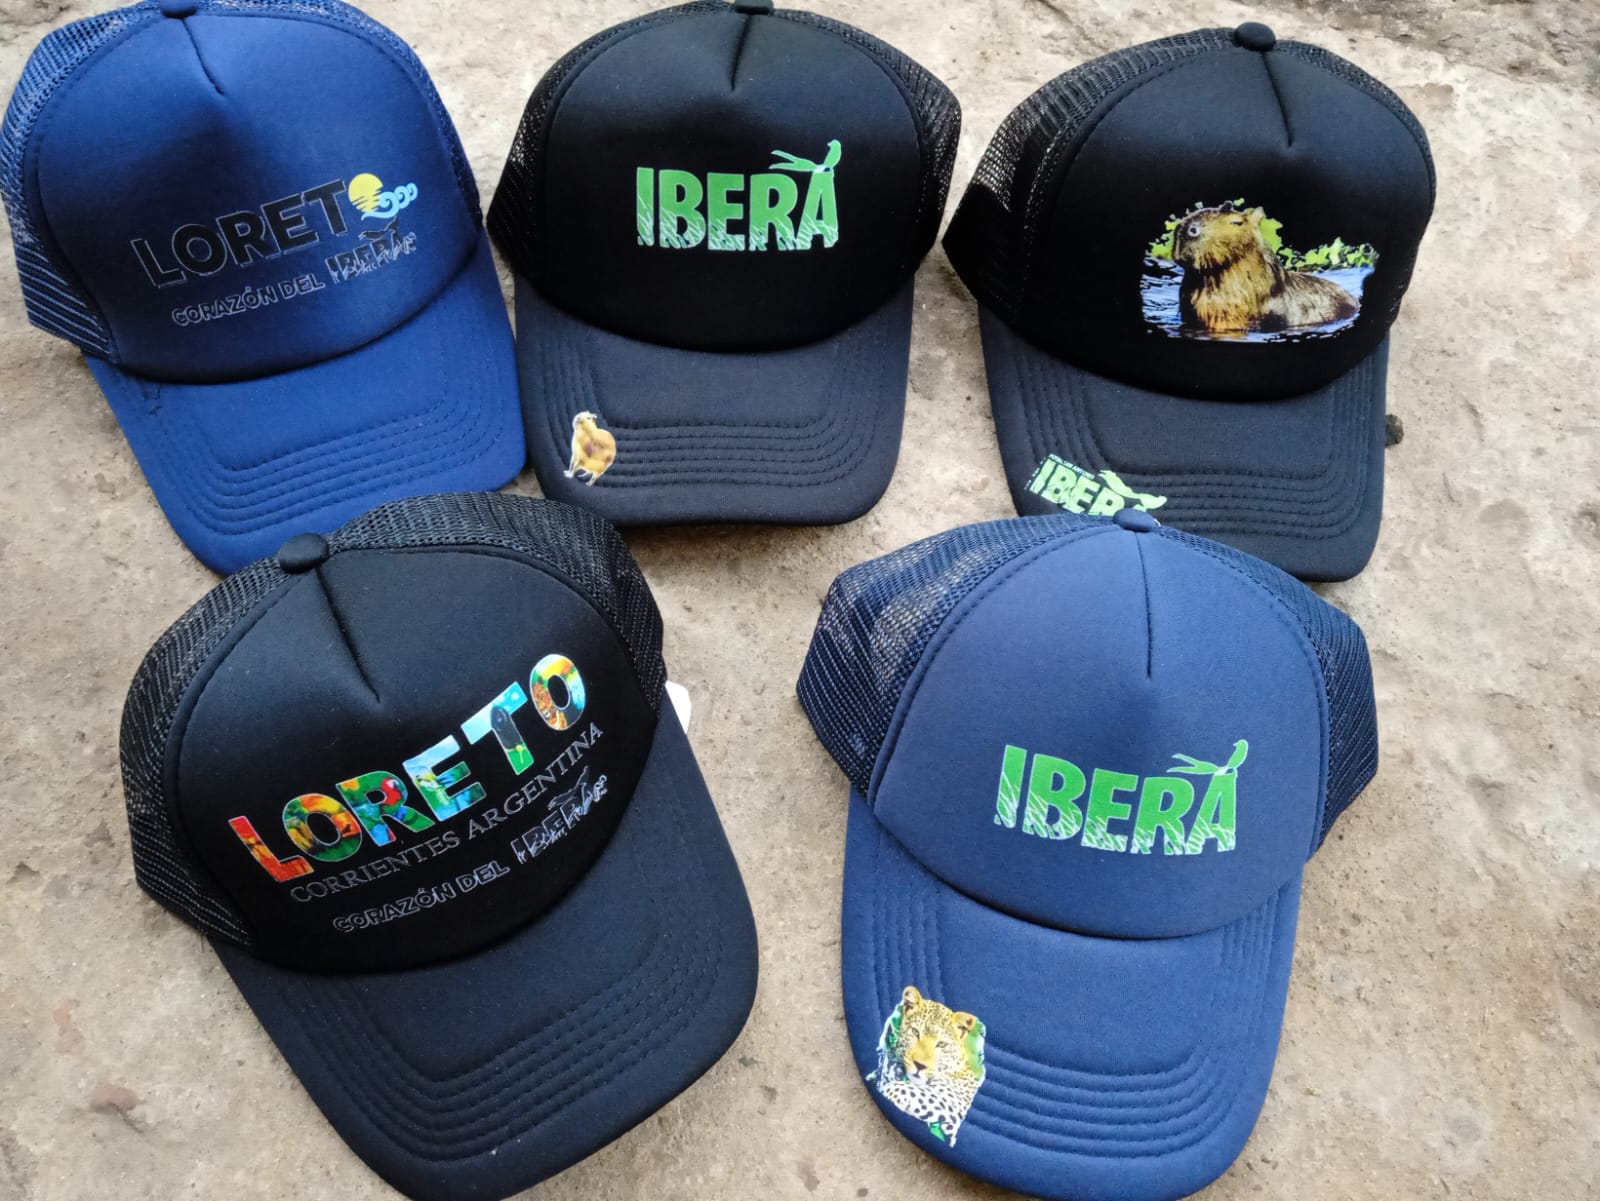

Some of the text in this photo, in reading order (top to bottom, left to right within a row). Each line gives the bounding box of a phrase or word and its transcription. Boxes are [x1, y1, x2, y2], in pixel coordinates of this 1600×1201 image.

[172, 286, 279, 326] CORAZÓN
[281, 273, 325, 300] DEL
[1029, 458, 1168, 517] IBER
[228, 653, 586, 883] LORETO
[289, 721, 604, 902] CORRIENTES ARGENTINA
[332, 886, 457, 932] CORAZÓN
[455, 859, 511, 894] DEL
